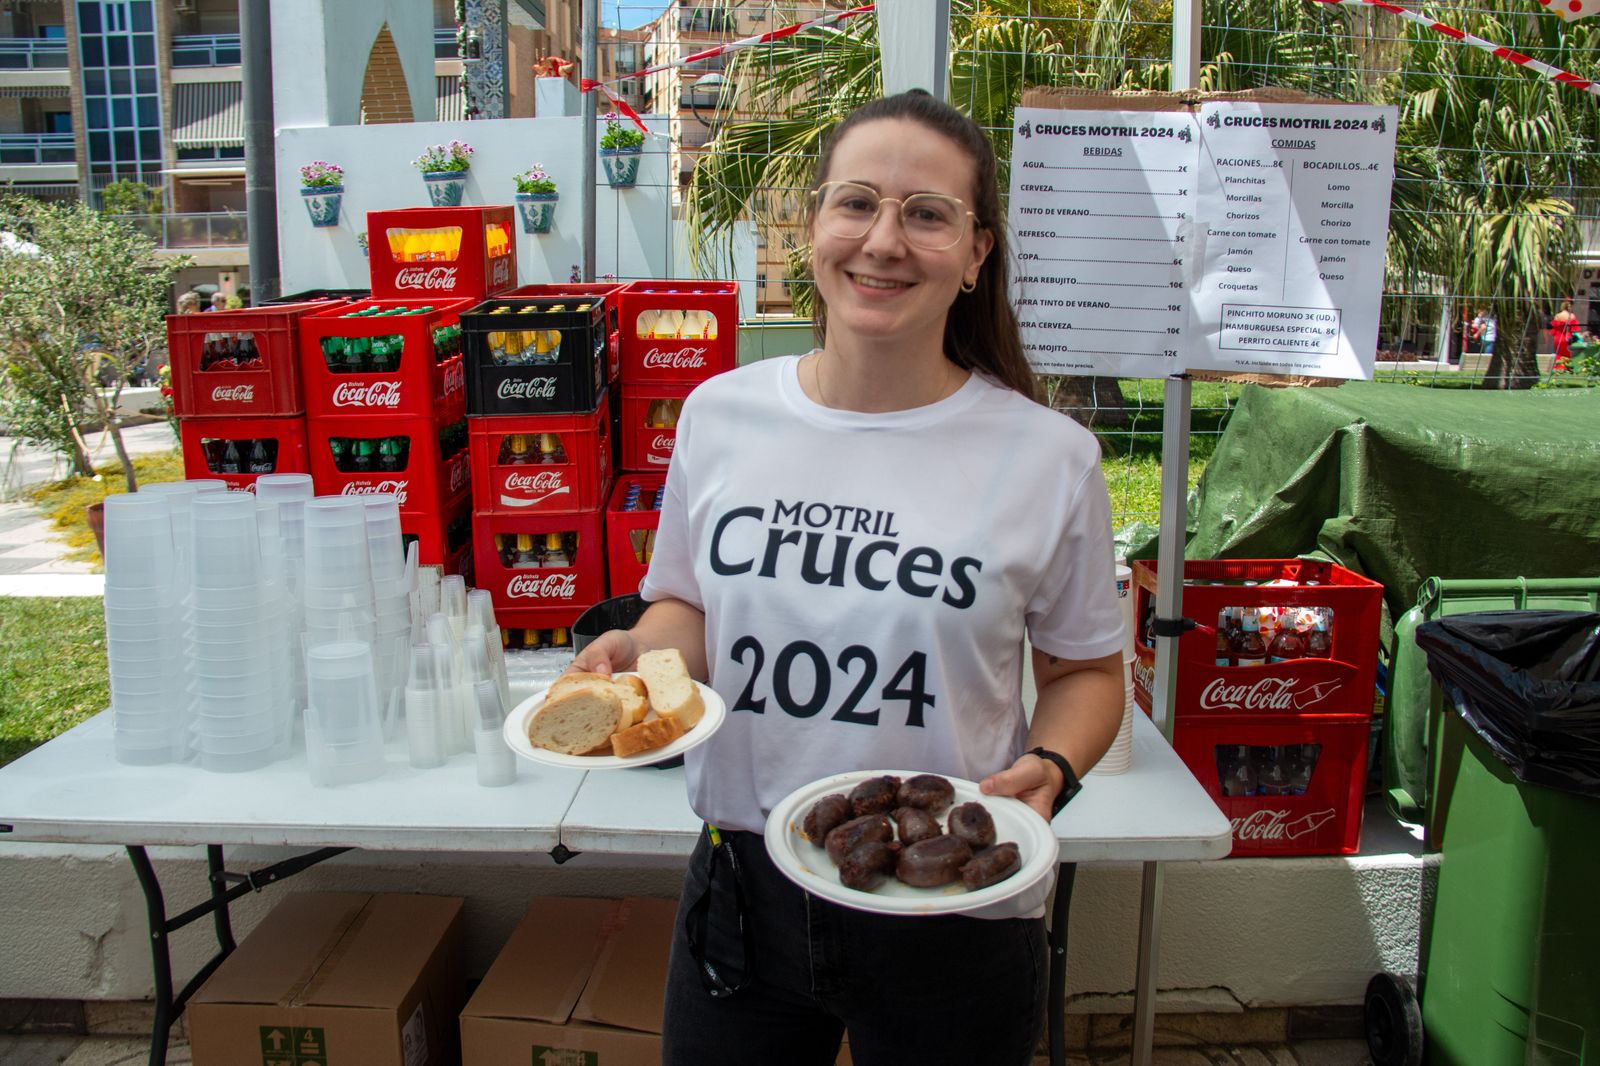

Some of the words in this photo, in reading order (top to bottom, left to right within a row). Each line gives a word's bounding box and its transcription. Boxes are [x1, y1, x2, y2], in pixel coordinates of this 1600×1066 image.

[1224, 116, 1278, 128] CRUCES
[1280, 118, 1331, 129] MOTRIL
[1334, 119, 1368, 130] 2024
[1035, 124, 1087, 136] CRUCES
[1088, 126, 1139, 137] MOTRIL
[1141, 127, 1174, 138] 2024
[1271, 139, 1316, 149] COMIDAS
[1083, 147, 1122, 156] BEBIDAS
[1225, 176, 1266, 185] Planchitas
[1327, 183, 1350, 191] Lomo
[1226, 194, 1262, 203] Morcillas
[1321, 201, 1354, 209] Morcilla
[1020, 207, 1043, 215] TINTO
[1176, 212, 1186, 220] 3€
[1226, 212, 1260, 220] Chorizos
[1321, 219, 1352, 227] Chorizo
[1207, 229, 1231, 238] Carne
[1248, 231, 1277, 239] tomate
[1299, 236, 1323, 244] Carne
[1340, 238, 1371, 246] tomate
[1227, 247, 1253, 256] Jamón
[1320, 255, 1346, 263] Jamón
[1227, 265, 1252, 274] Queso
[395, 267, 457, 290] Coca-Cola
[1319, 273, 1344, 281] Queso
[1218, 283, 1258, 291] Croquetas
[1015, 299, 1038, 307] JARRA
[1040, 299, 1064, 307] TINTO
[1227, 310, 1265, 318] PINCHITO
[1267, 312, 1303, 320] MORUNO
[1316, 314, 1336, 322] (UD.)
[1225, 323, 1285, 333] HAMBURGUESA
[1238, 337, 1271, 345] PERRITO
[1272, 339, 1309, 347] CALIENTE
[643, 347, 708, 369] Coca-Cola
[212, 385, 255, 402] Coca-Cola
[497, 377, 558, 400] Coca-Cola
[332, 381, 402, 407] Coca-Cola
[505, 471, 563, 490] Coca-Cola
[771, 499, 899, 537] MOTRIL
[709, 506, 983, 609] Cruces
[506, 573, 578, 599] Coca-Cola
[730, 635, 936, 728] 2024
[1200, 678, 1300, 710] Coca-Cola
